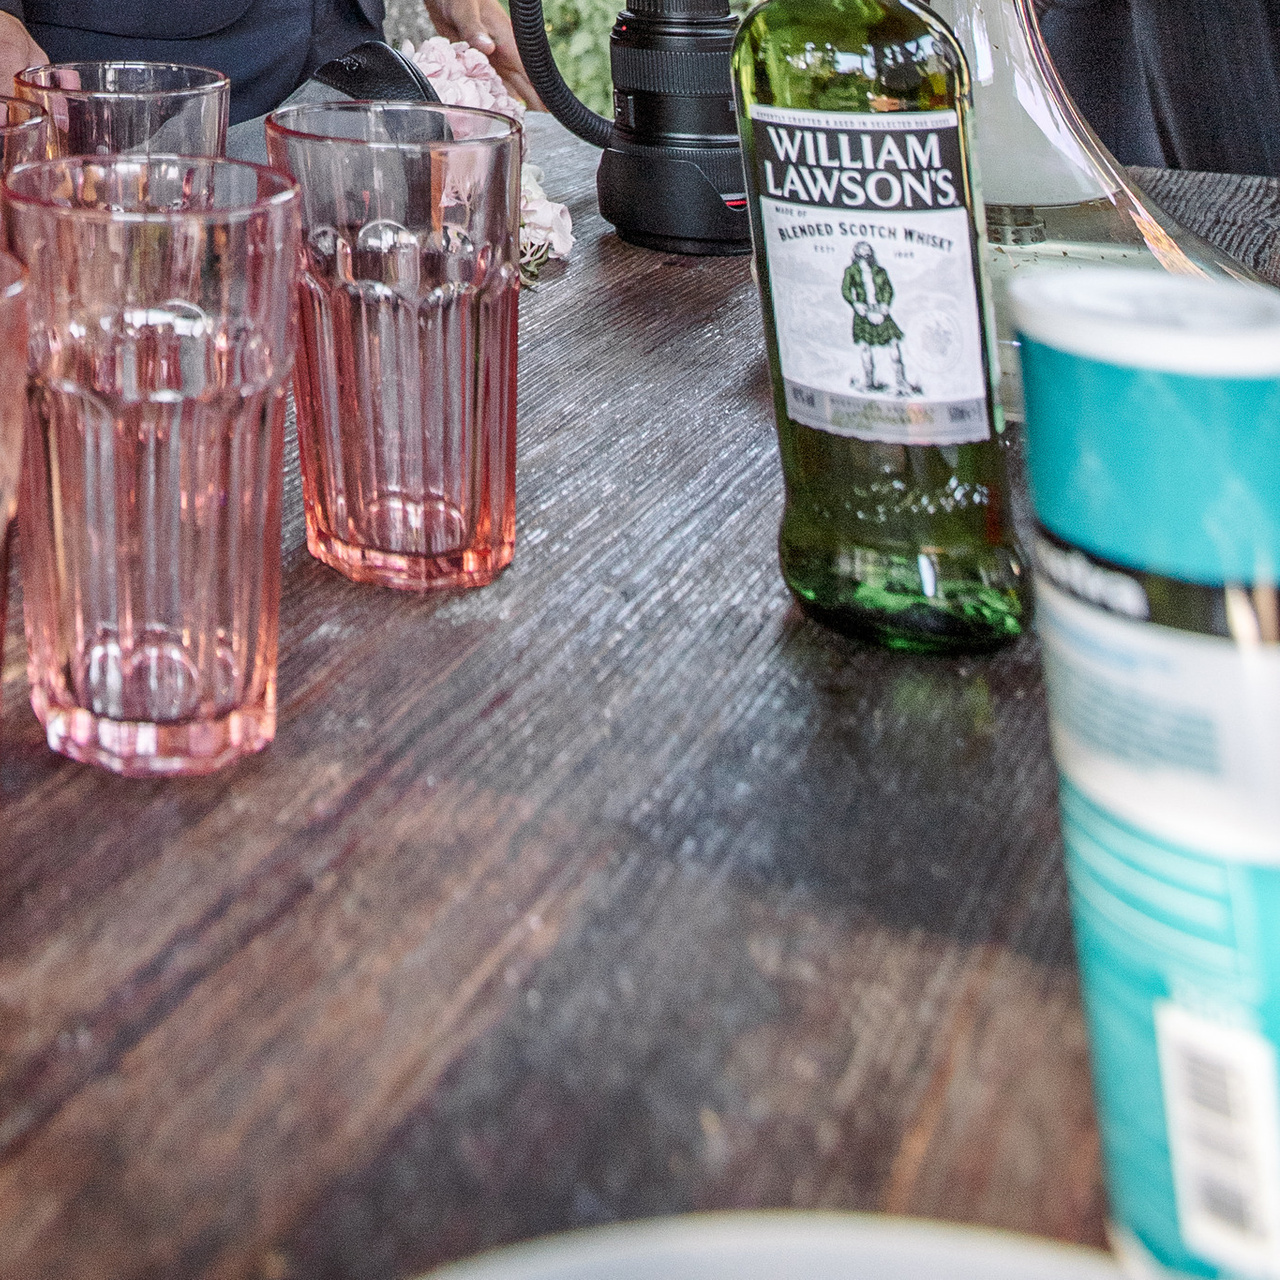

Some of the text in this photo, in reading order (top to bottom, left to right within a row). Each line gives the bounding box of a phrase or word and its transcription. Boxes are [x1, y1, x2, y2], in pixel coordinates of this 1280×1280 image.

[766, 125, 942, 170] WILLIAM
[764, 159, 956, 208] LAWSON'S
[774, 205, 795, 217] MADE
[777, 221, 954, 253] BLENDED SCOTCH WHISKY
